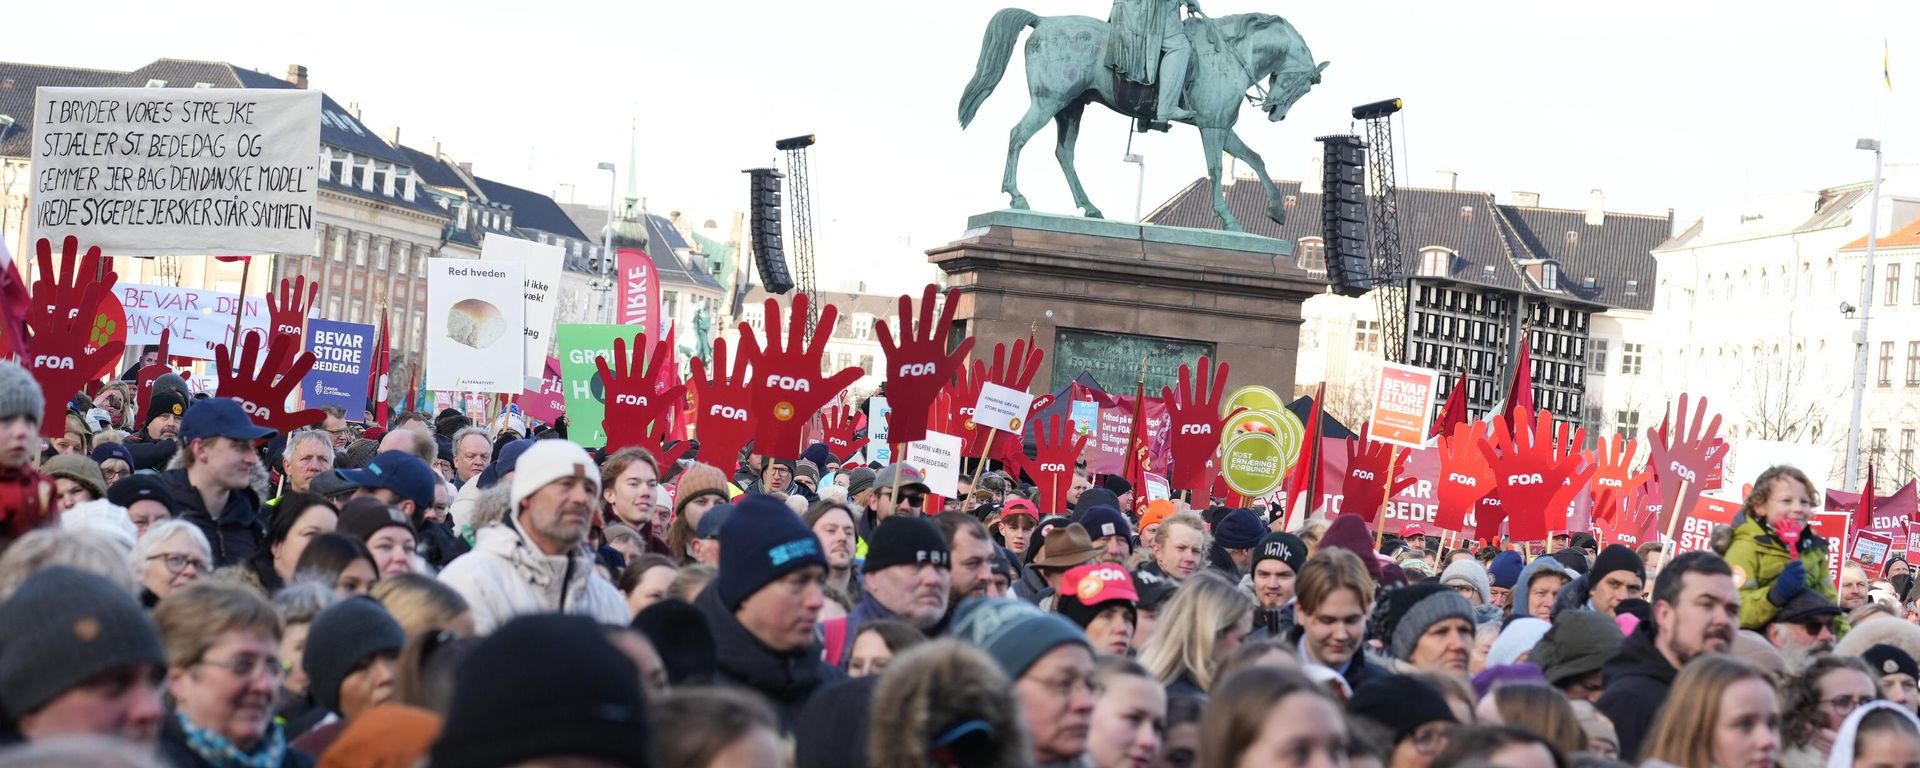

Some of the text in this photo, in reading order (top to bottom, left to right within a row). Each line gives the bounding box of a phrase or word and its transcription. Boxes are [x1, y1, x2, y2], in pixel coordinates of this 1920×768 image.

[45, 100, 56, 124] I
[60, 100, 120, 124] BRYDER
[126, 101, 173, 124] VORES
[43, 132, 118, 156] STJÆLER
[148, 133, 225, 158] BEDEDAG
[238, 133, 262, 157] OG
[40, 167, 99, 193] GEMMER
[104, 166, 134, 191] JER
[137, 167, 166, 190] BAG
[38, 195, 312, 230] VREDE SYGEPLEJERSKER STÅR SAMMEN
[448, 267, 506, 278] Red hveden
[531, 279, 549, 291] ikke
[123, 288, 257, 317] BEVAR DEN
[126, 313, 199, 340] ANSKE
[278, 324, 300, 335] FOA
[315, 330, 363, 349] BEVAR
[313, 345, 361, 363] STORE
[569, 349, 634, 364] GRØT
[34, 355, 74, 369] FOA
[312, 361, 359, 375] BEDEDAG
[899, 362, 936, 377] FOA
[766, 374, 810, 392] FOA
[1383, 378, 1427, 396] BEVAR
[616, 394, 648, 406] FOA
[1033, 397, 1049, 410] FOA
[1381, 389, 1425, 408] STORE
[710, 404, 747, 421] FOA
[960, 407, 975, 415] FO
[1379, 401, 1423, 417] BEDEDAG
[1181, 423, 1211, 435] FOA
[829, 437, 847, 447] FOA
[1109, 434, 1129, 445] fingren
[1232, 451, 1252, 459] KOST
[1040, 463, 1065, 471] FOA
[1231, 463, 1276, 474] FORBUNDET
[1232, 458, 1277, 468] ERNÆRINGS
[1352, 469, 1374, 481] FOA
[1670, 461, 1696, 483] FOA
[1449, 472, 1476, 487] FOA
[1508, 473, 1543, 486] FOA
[1599, 477, 1622, 487] FOA
[1618, 534, 1637, 544] FOA
